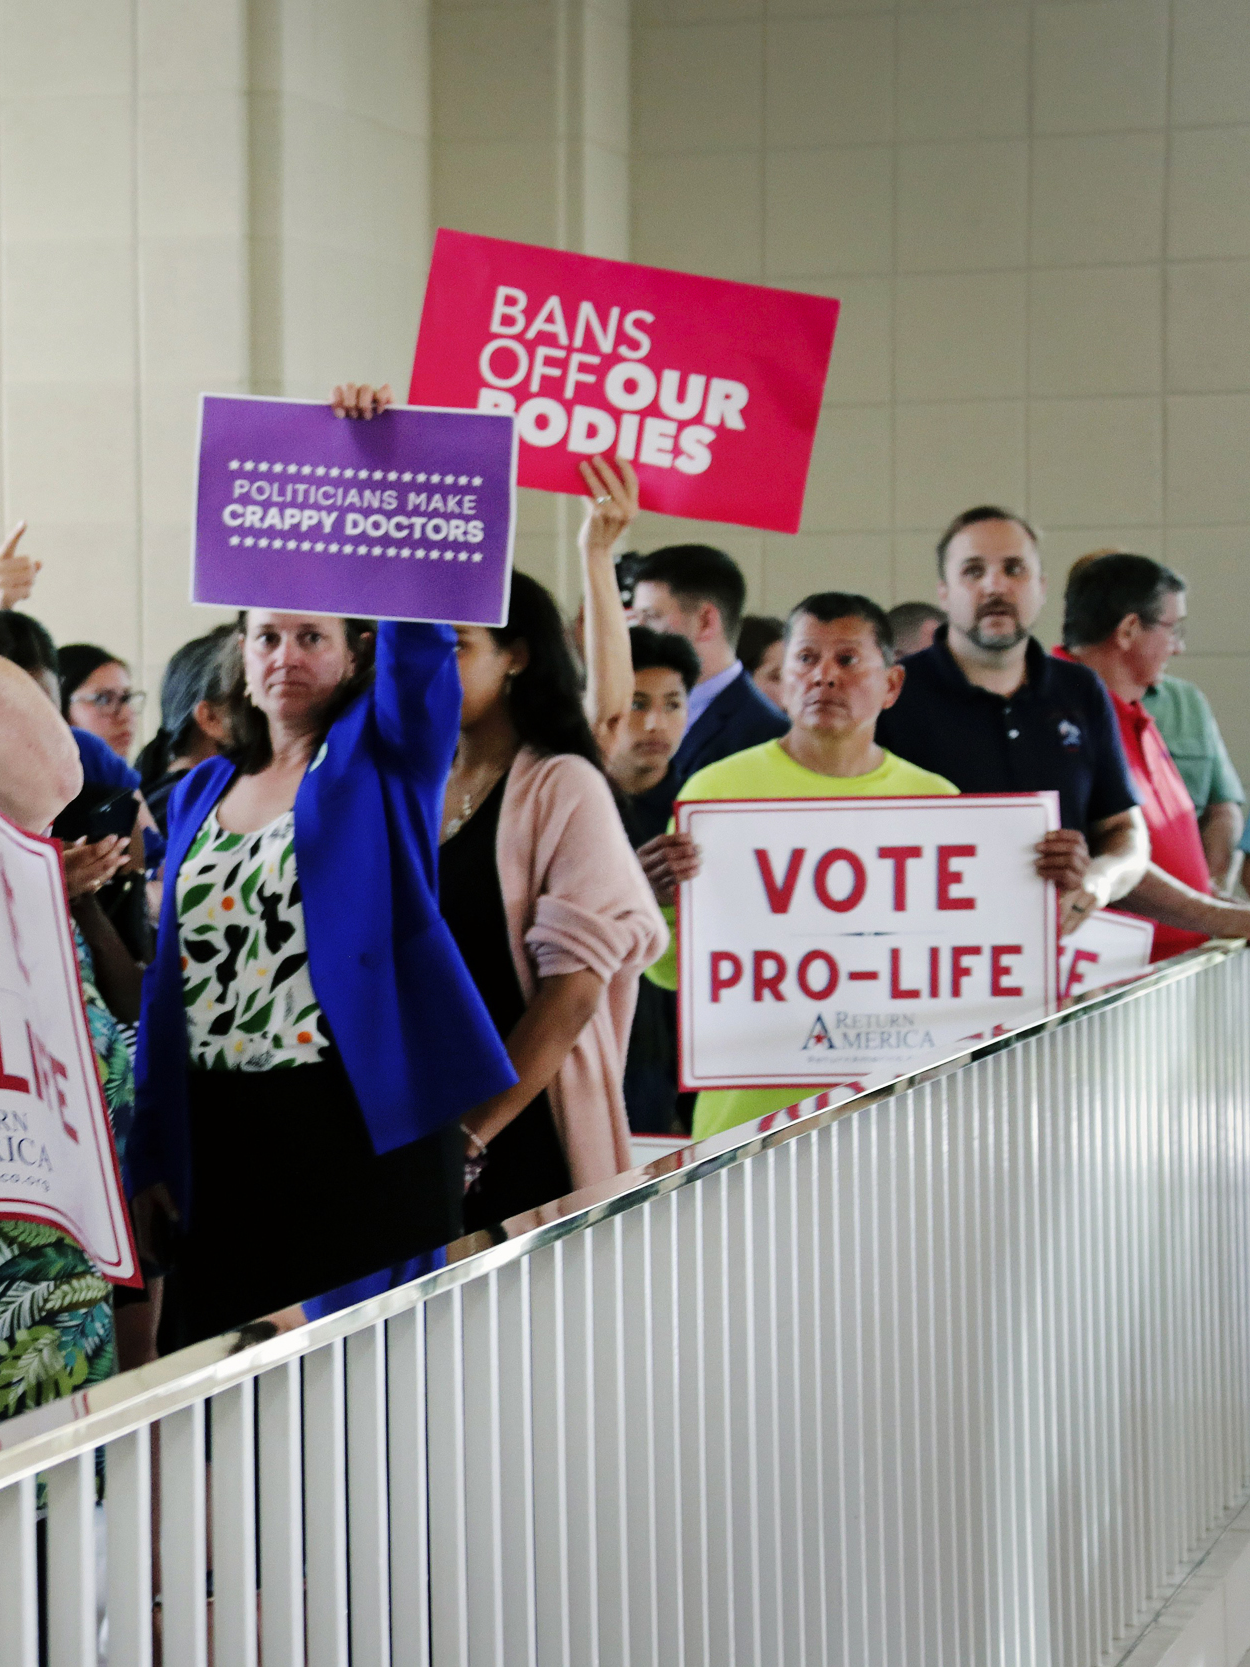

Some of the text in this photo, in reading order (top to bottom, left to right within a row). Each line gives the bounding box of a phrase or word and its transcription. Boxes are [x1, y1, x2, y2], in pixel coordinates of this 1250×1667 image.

[490, 285, 655, 360] BANS
[479, 338, 749, 431] OFF OUR
[222, 503, 485, 544] CRAPPY DOCTORS
[233, 479, 478, 515] POLITICIANS MAKE
[754, 844, 977, 914] VOTE
[709, 945, 1023, 1003] PRO-LIFE
[801, 1013, 936, 1051] AMERICA
